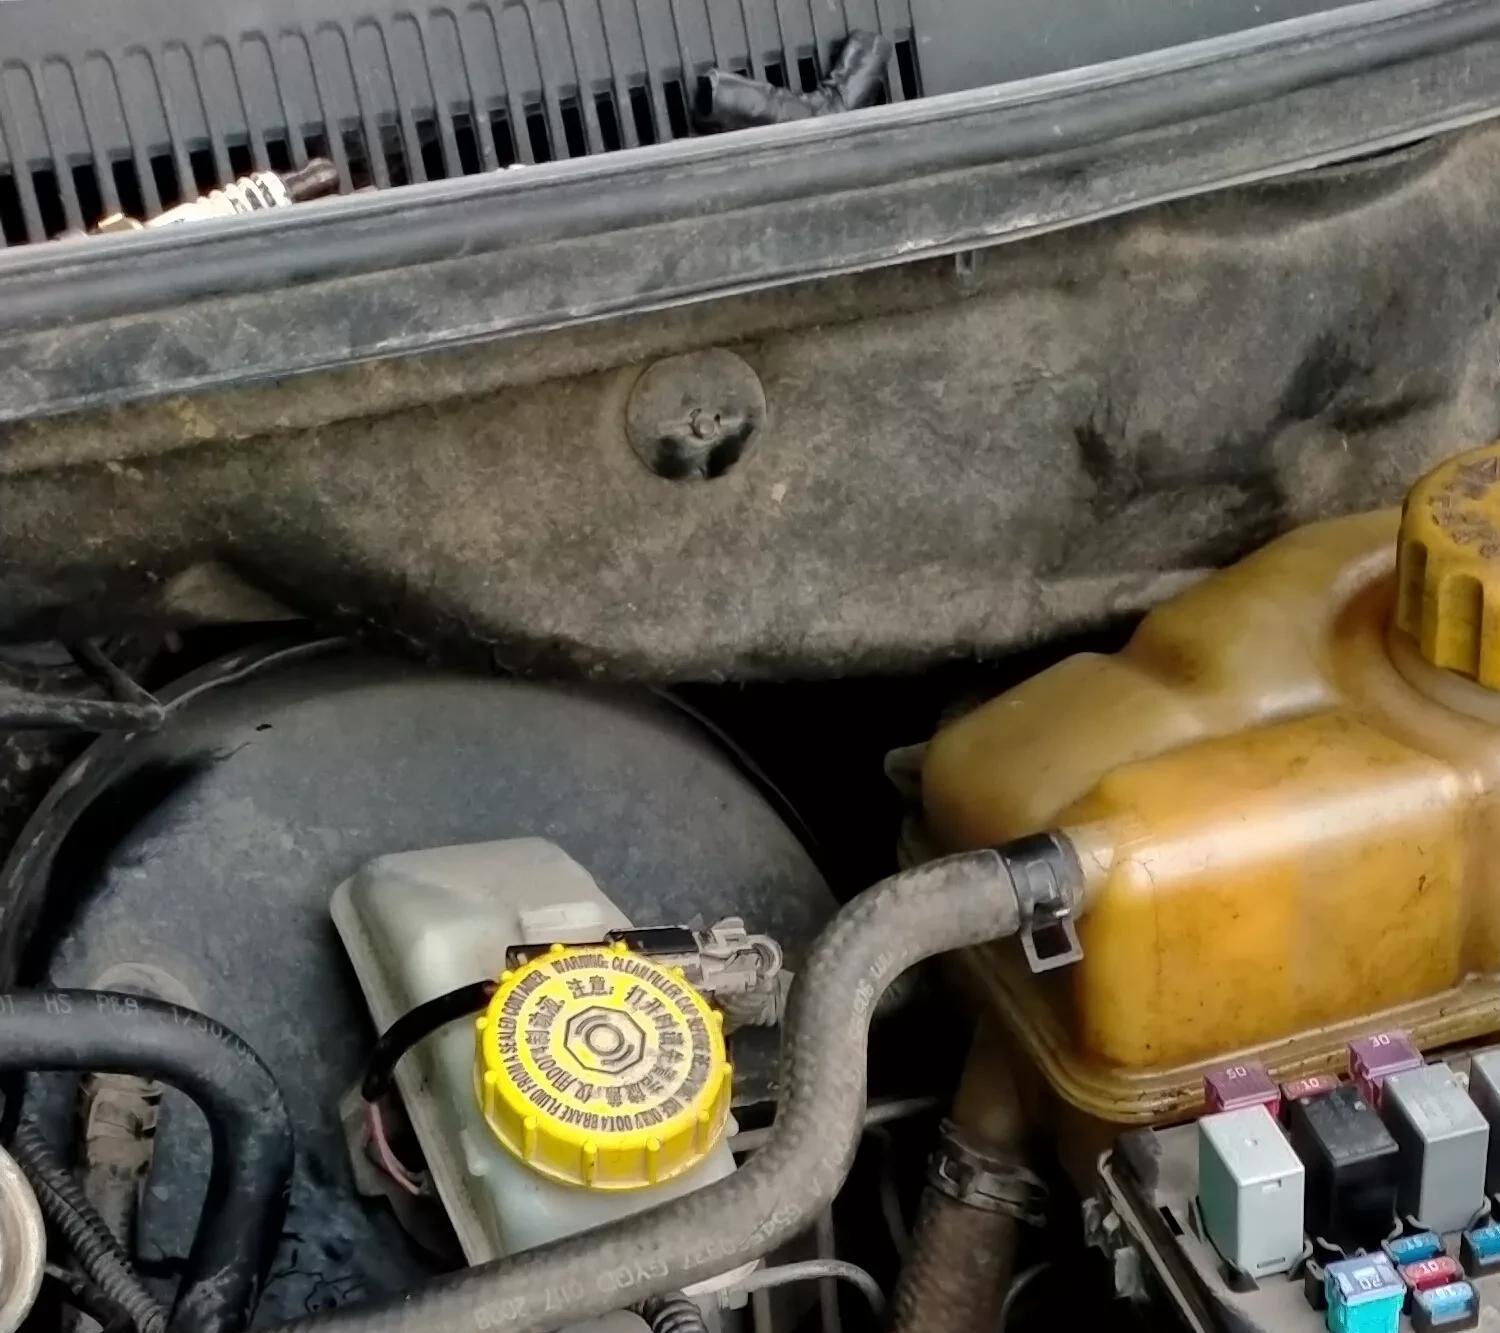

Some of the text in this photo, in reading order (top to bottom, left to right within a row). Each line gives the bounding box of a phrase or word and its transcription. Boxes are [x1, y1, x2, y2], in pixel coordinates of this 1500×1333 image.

[497, 1015, 517, 1053] SEALED
[1369, 1034, 1390, 1047] 30
[506, 1063, 535, 1093] FROM
[1300, 1077, 1320, 1089] 10
[526, 1087, 563, 1116] FLUID
[556, 1105, 598, 1130] BRAKE
